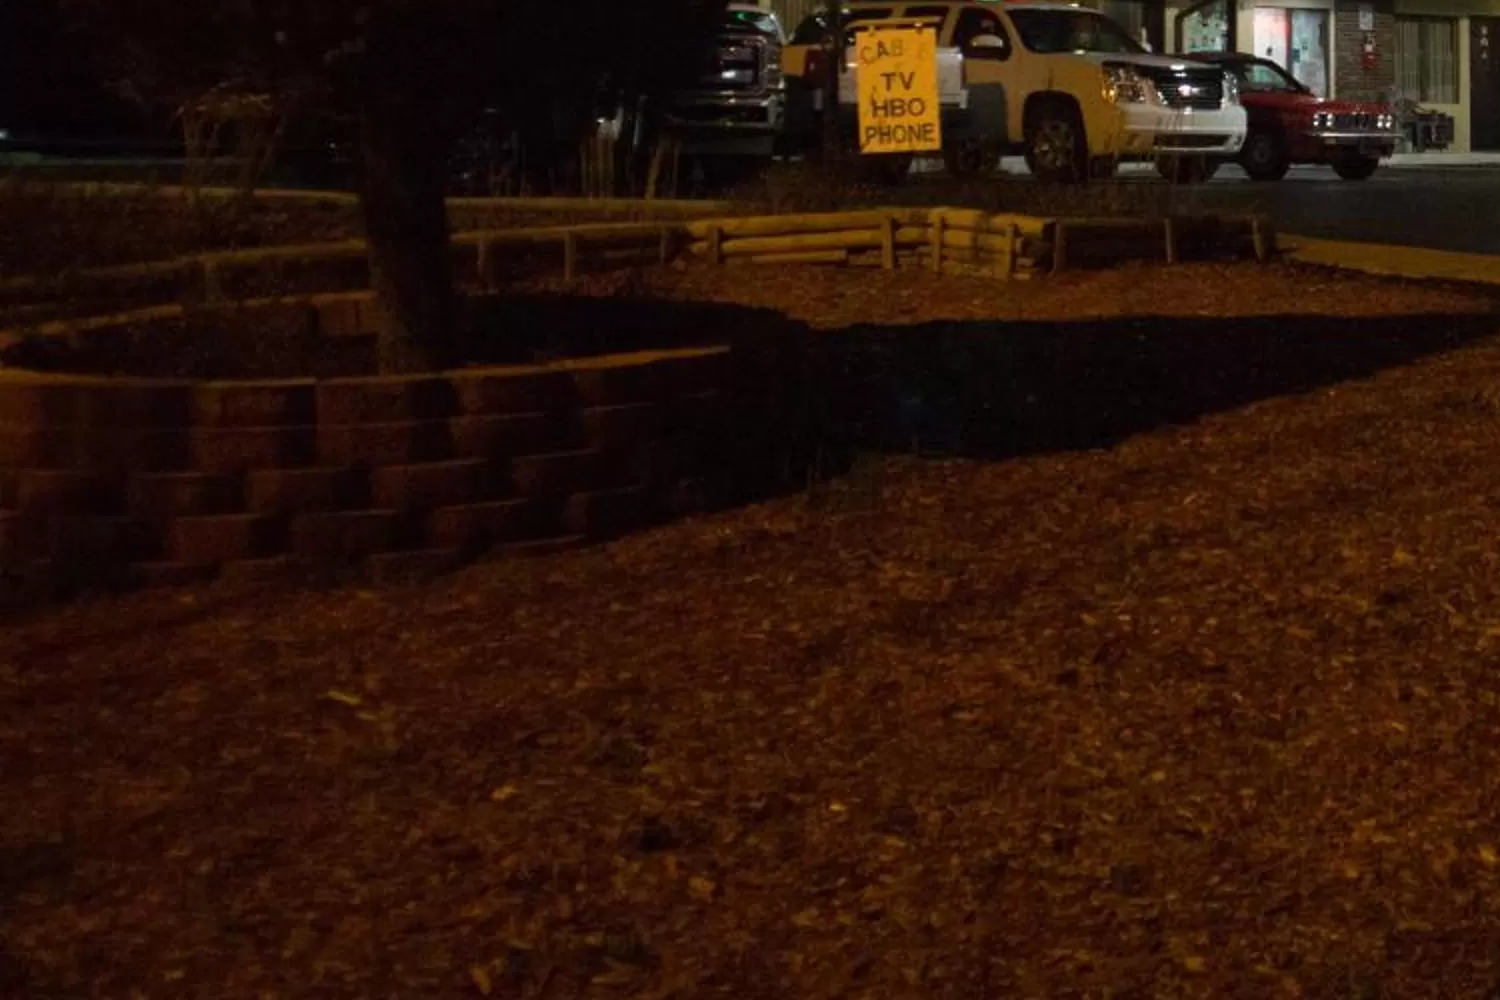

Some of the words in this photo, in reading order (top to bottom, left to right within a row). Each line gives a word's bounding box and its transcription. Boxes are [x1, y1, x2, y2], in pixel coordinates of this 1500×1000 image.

[880, 71, 915, 92] TV
[871, 97, 926, 118] HBO
[863, 123, 936, 146] PHONE
